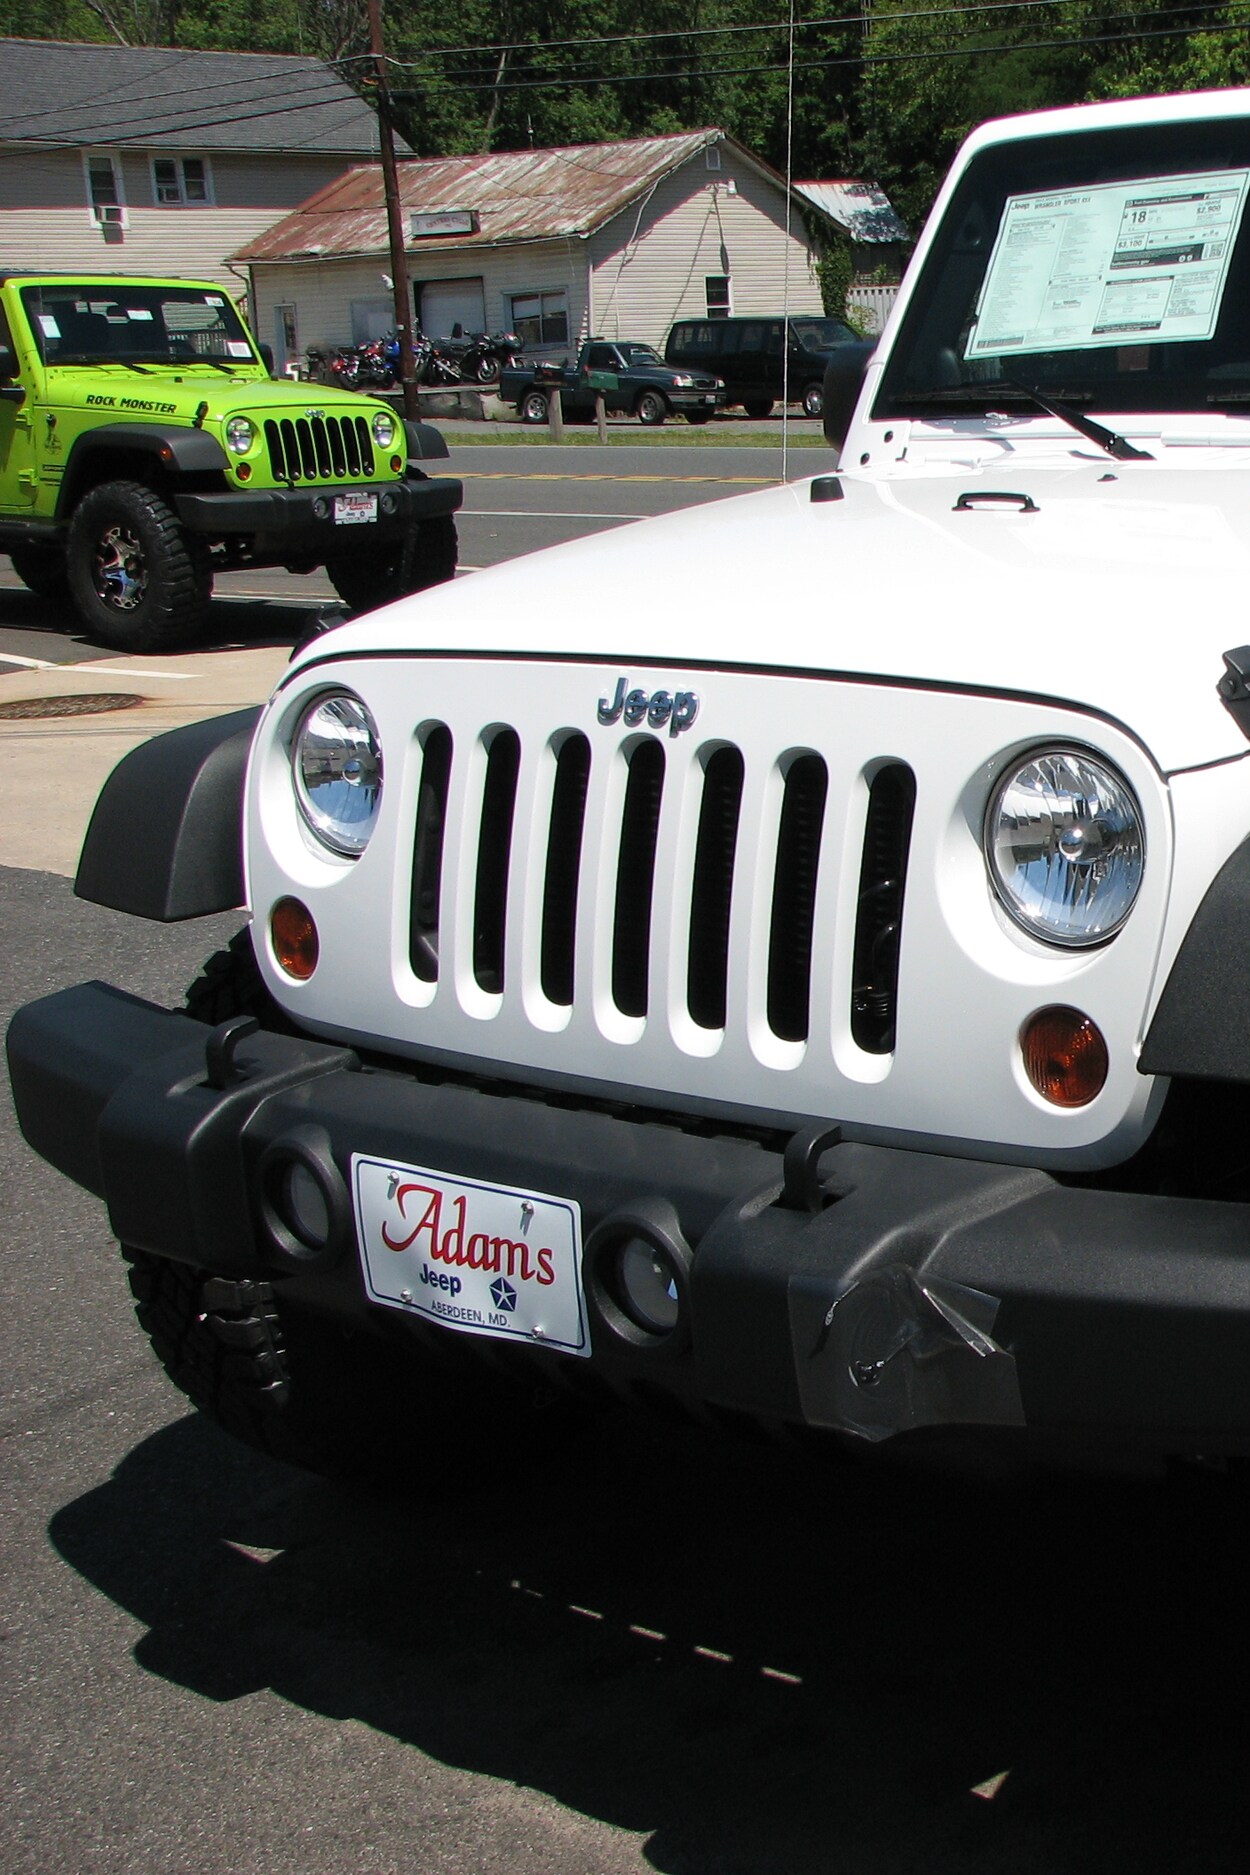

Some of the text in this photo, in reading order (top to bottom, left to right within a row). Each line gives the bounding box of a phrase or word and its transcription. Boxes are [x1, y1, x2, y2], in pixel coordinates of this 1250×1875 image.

[1011, 202, 1030, 210] Jeep
[1131, 210, 1147, 224] 18
[1118, 240, 1143, 249] $3,100
[86, 394, 177, 414] ROCK MONSTER
[597, 676, 700, 739] Jeep
[381, 1183, 556, 1286] Adams
[419, 1262, 463, 1298] Jeep
[431, 1300, 512, 1328] ABERDEEN, MD.
